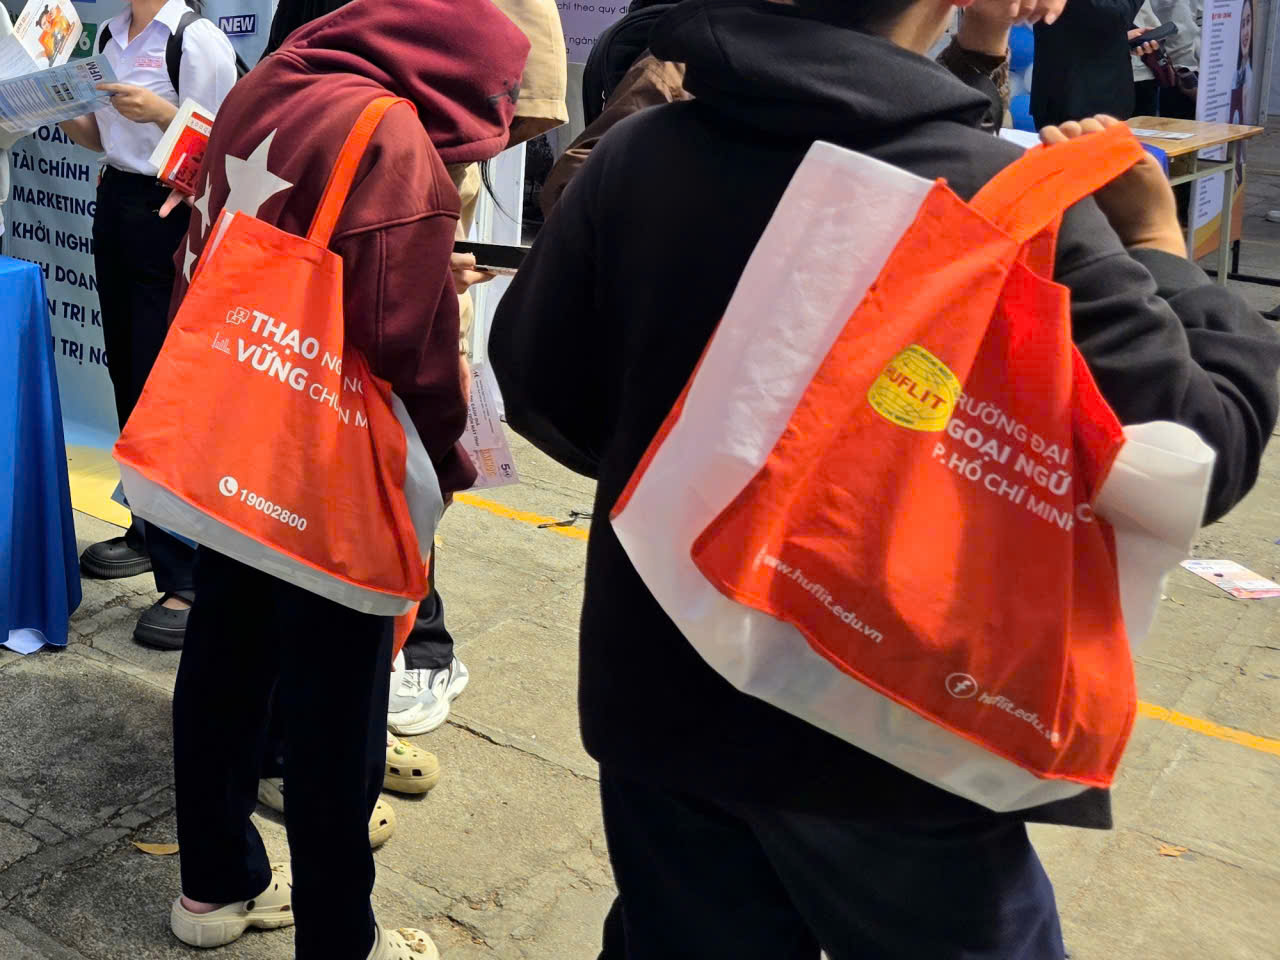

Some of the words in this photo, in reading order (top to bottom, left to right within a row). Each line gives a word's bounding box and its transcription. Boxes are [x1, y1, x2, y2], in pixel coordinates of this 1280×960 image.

[221, 16, 254, 35] NEW
[12, 151, 35, 171] TÀI
[38, 157, 91, 182] CHÍNH
[12, 185, 97, 219] MARKETING
[12, 220, 51, 244] KHỞI
[250, 310, 320, 360] THẠO
[237, 338, 309, 391] VỮNG
[1030, 433, 1070, 465] ĐẠI
[948, 452, 982, 481] HỒ
[983, 473, 1026, 504] CHÍ
[1014, 453, 1073, 497] NGỮ
[239, 488, 308, 532] 19002800
